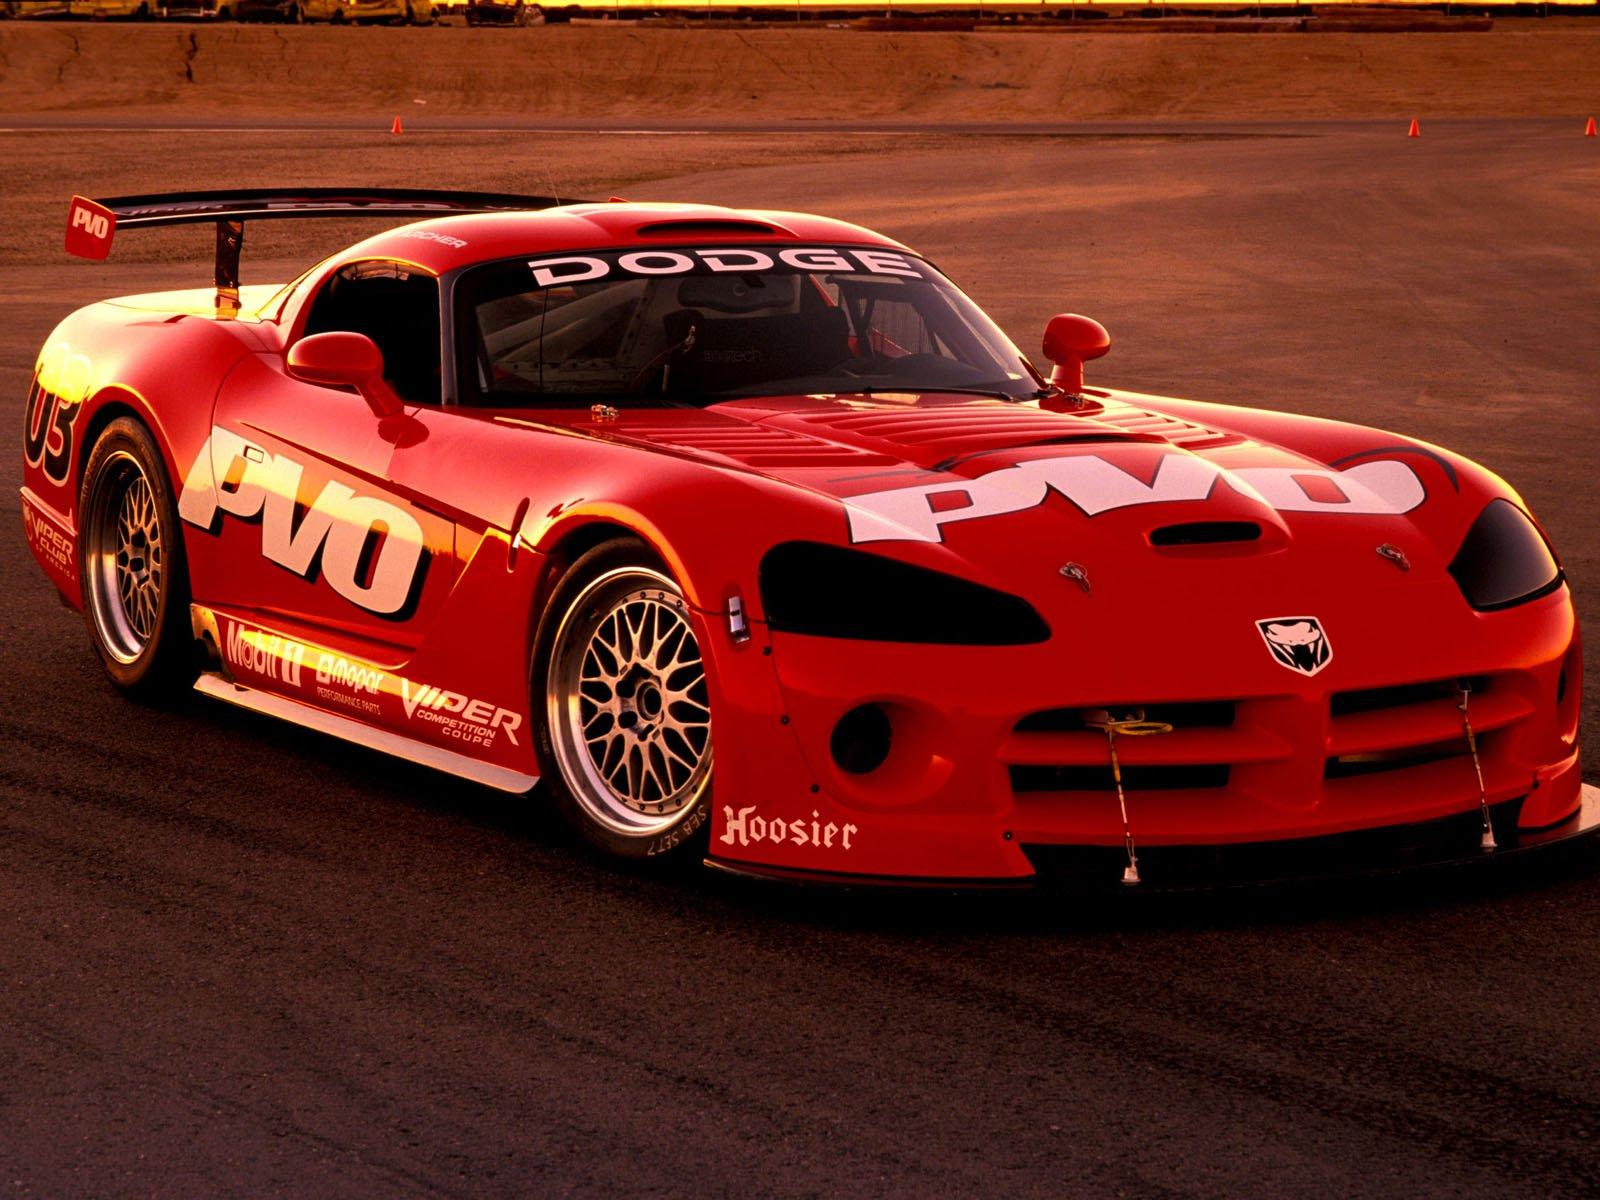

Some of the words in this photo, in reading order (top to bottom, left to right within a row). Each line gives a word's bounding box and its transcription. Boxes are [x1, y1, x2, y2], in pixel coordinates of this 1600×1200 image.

[72, 206, 109, 239] PVO
[528, 249, 923, 287] DODGE
[178, 425, 424, 614] PVO
[843, 455, 1426, 544] PVO
[31, 511, 74, 565] VIPER
[40, 536, 67, 565] CLUB
[227, 620, 281, 679] Mobil
[401, 677, 523, 747] VIPER
[416, 709, 497, 739] COMPETITION
[442, 726, 493, 748] COUPE
[719, 805, 858, 850] Hoosier
